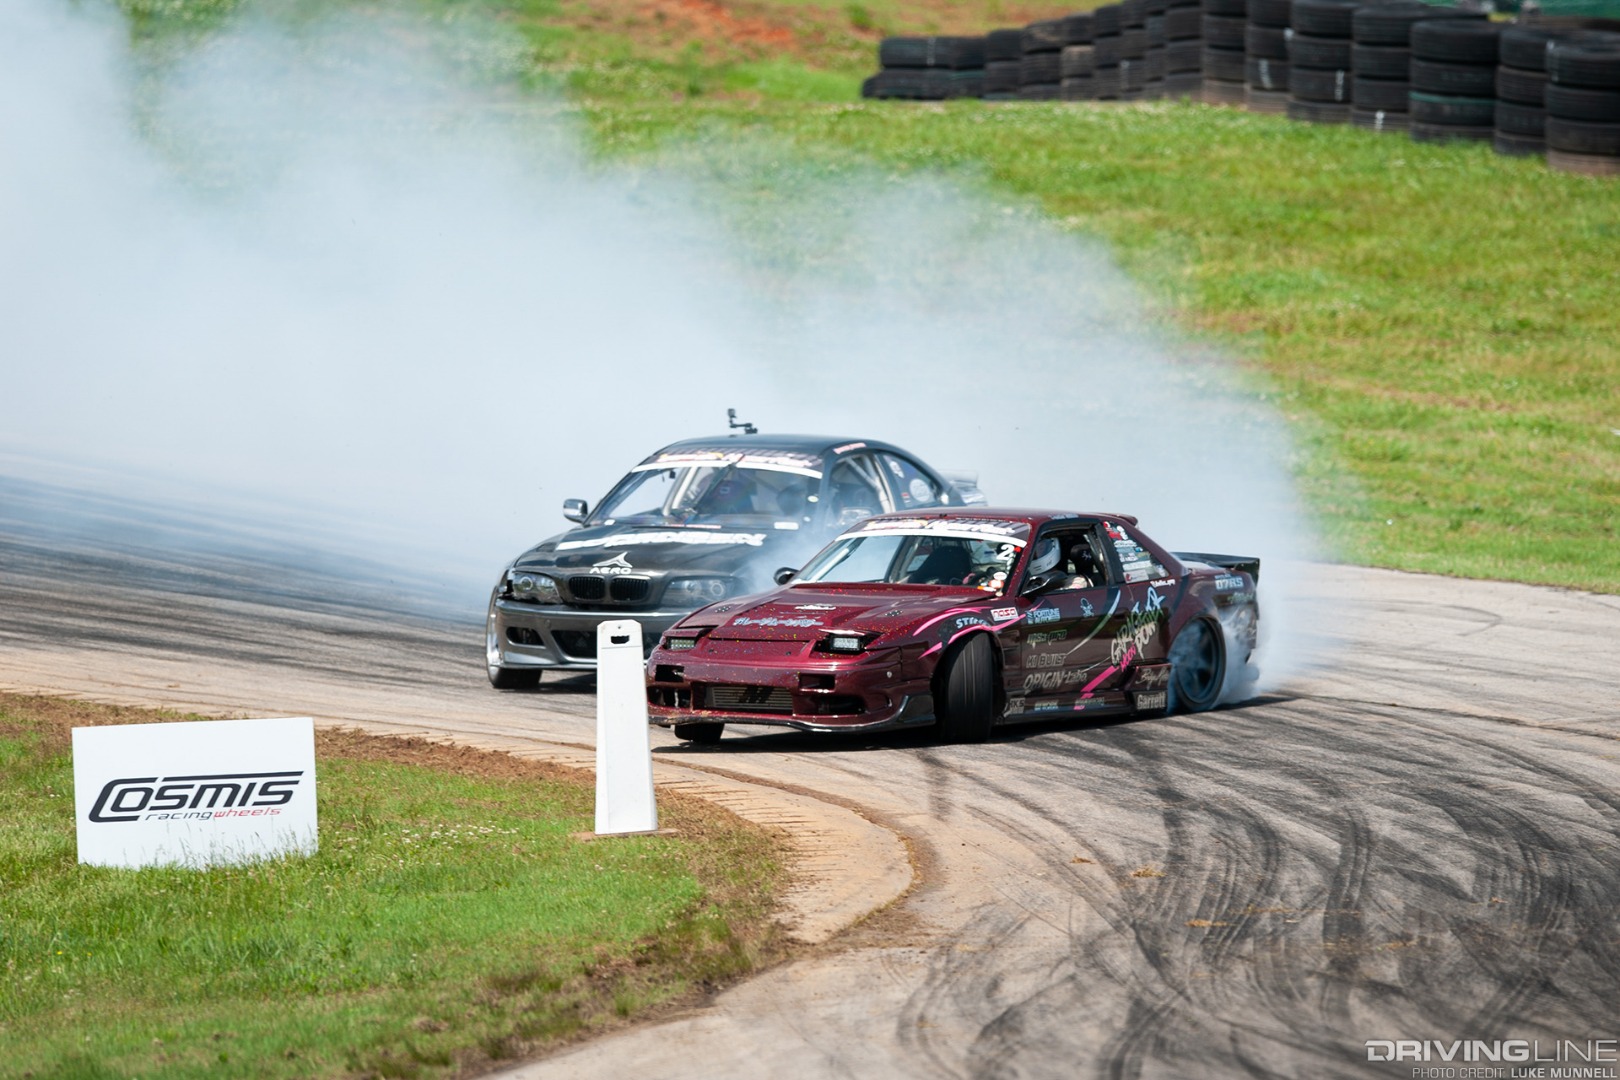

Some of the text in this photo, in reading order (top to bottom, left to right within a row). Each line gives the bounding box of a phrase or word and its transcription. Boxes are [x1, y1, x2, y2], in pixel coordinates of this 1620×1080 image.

[588, 566, 632, 575] AERO
[1137, 692, 1166, 710] Garrett
[88, 770, 304, 823] COSMIS
